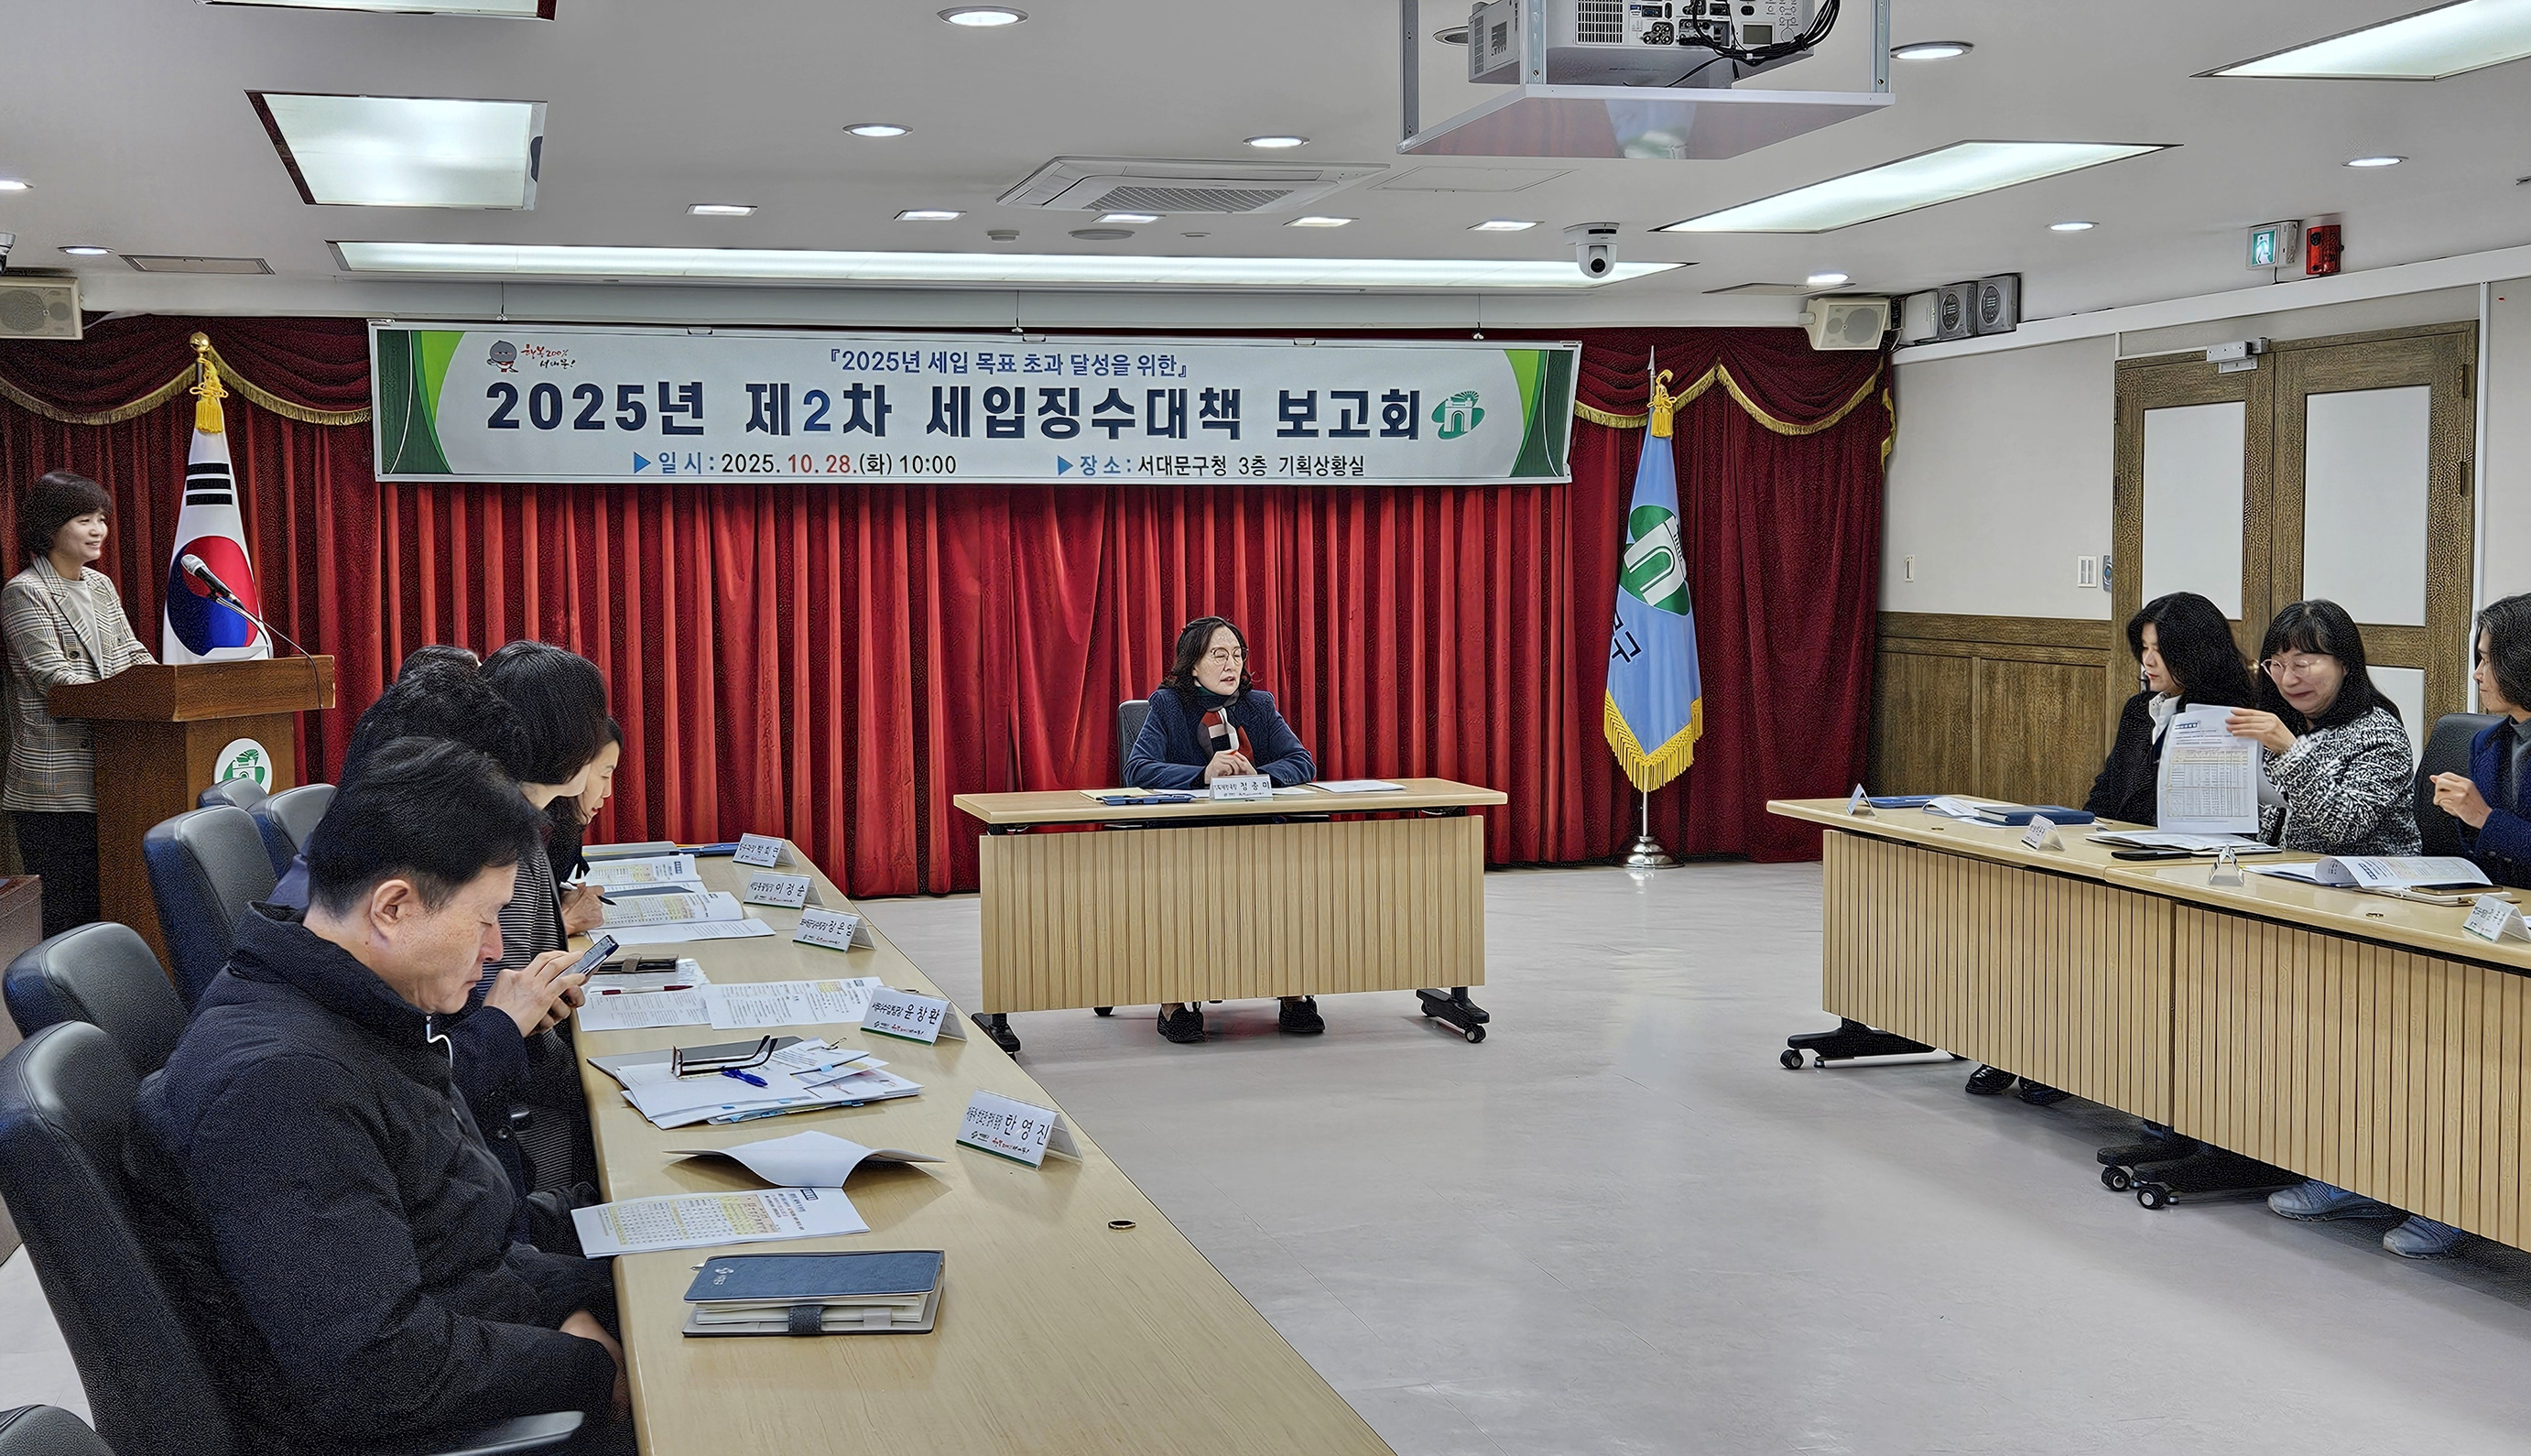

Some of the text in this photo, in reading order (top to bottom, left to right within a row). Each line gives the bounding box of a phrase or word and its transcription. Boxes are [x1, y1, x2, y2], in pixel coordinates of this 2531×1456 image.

[928, 351, 968, 375] 세입
[975, 352, 1017, 375] 목표
[1022, 353, 1064, 376] 초과
[1070, 353, 1132, 376] 달성을
[486, 381, 1420, 440] 2025년 제2차 세입징수대책 보고회
[721, 453, 781, 474] 2025.
[899, 455, 957, 474] 10:00
[1137, 455, 1228, 476] 서대문구청
[1238, 455, 1267, 476] 3층
[1278, 455, 1365, 477] 기획상황실
